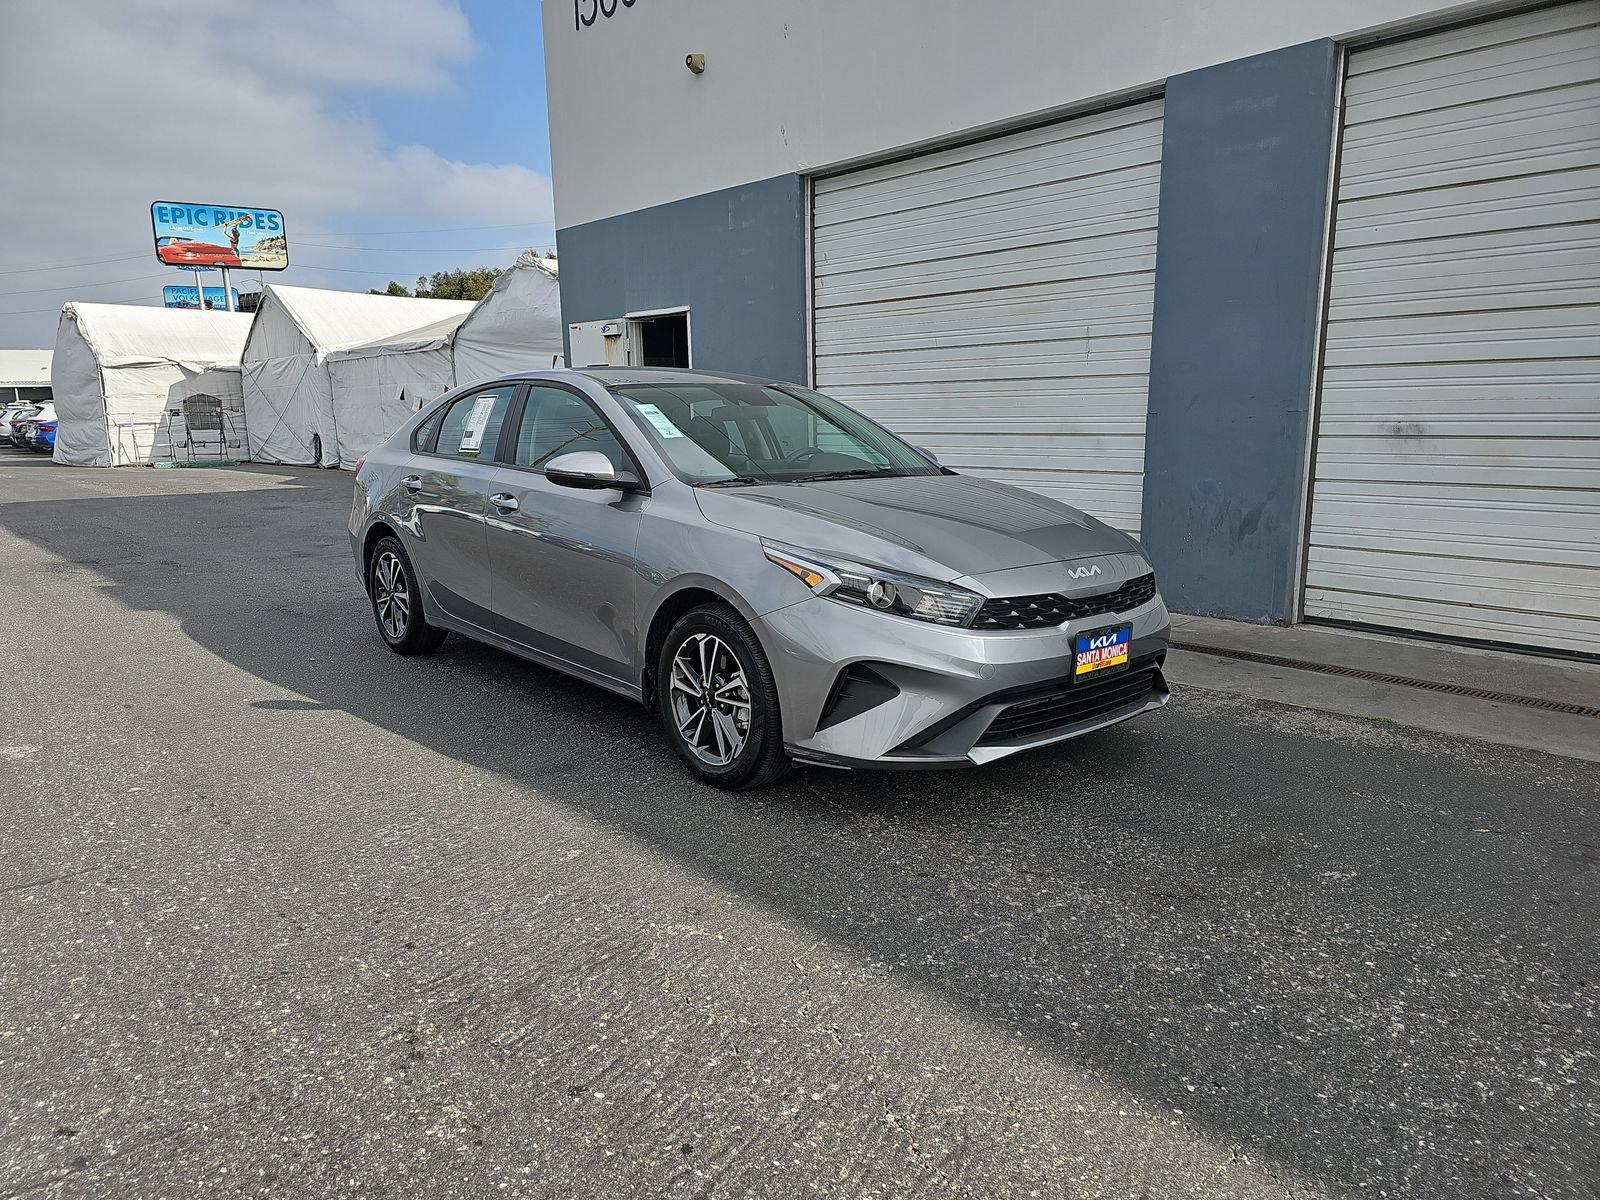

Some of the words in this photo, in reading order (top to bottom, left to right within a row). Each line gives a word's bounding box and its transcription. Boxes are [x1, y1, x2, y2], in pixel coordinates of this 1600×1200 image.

[574, 0, 637, 31] 15
[157, 206, 208, 226] EPIC
[214, 210, 280, 230] RIDES
[173, 294, 225, 302] VOLKSAGE
[1068, 564, 1102, 579] KIA
[1090, 633, 1118, 650] KIA
[1077, 650, 1100, 666] SANTA
[1101, 642, 1128, 660] MONICA
